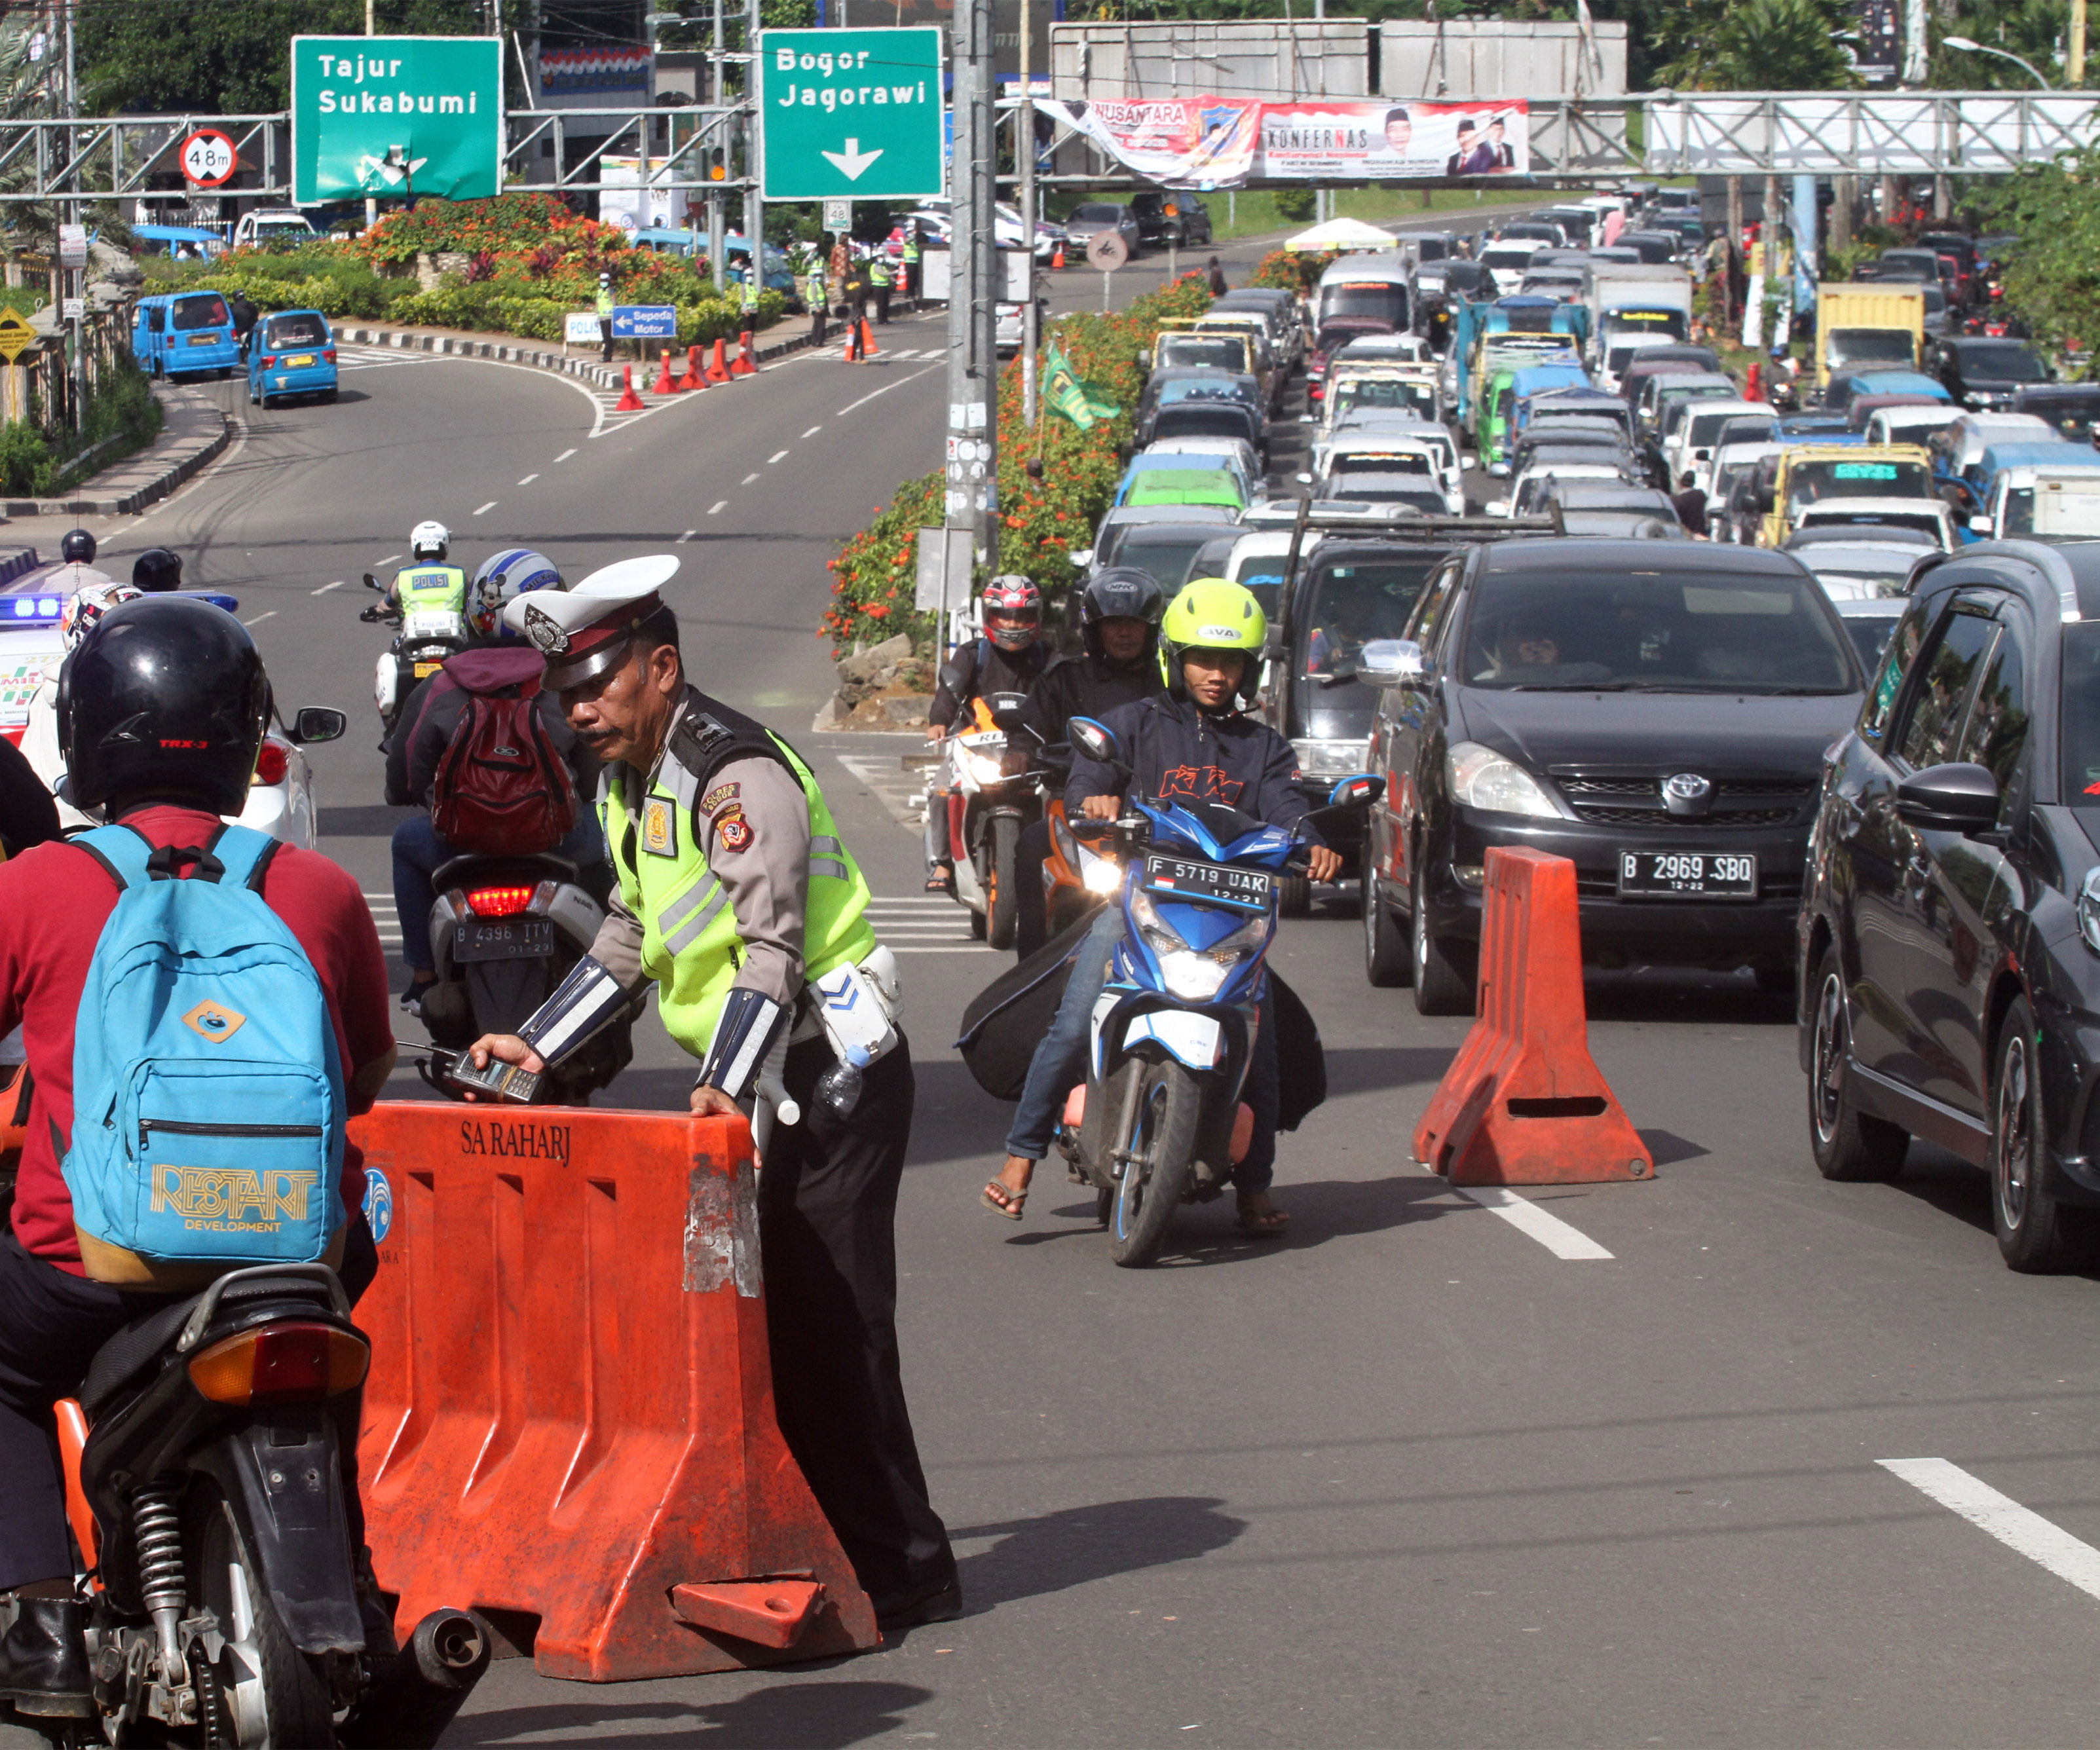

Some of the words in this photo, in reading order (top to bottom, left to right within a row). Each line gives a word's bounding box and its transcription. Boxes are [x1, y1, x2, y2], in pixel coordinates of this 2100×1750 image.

[319, 55, 402, 84] Tajur
[776, 48, 871, 77] Bogor
[318, 90, 478, 115] Sukabumi
[779, 81, 926, 113] Jagorawi
[1094, 103, 1186, 124] NUSANTARA
[1267, 129, 1368, 148] KONFERNAS
[633, 310, 673, 322] Sepeda
[570, 321, 601, 335] POLIS
[634, 325, 664, 334] Motor
[413, 575, 449, 588] POLISI
[703, 784, 736, 808] POLRES
[1158, 764, 1244, 806] KTM
[708, 791, 733, 811] BOGOR
[1152, 859, 1163, 873] F
[1174, 863, 1219, 884] 5719
[1228, 872, 1265, 893] UAK
[1624, 855, 1637, 878] B
[1653, 855, 1704, 880] 2969
[457, 927, 466, 942] B
[150, 1163, 318, 1221] RESTART
[184, 1219, 282, 1234] DEVELOPMENT
